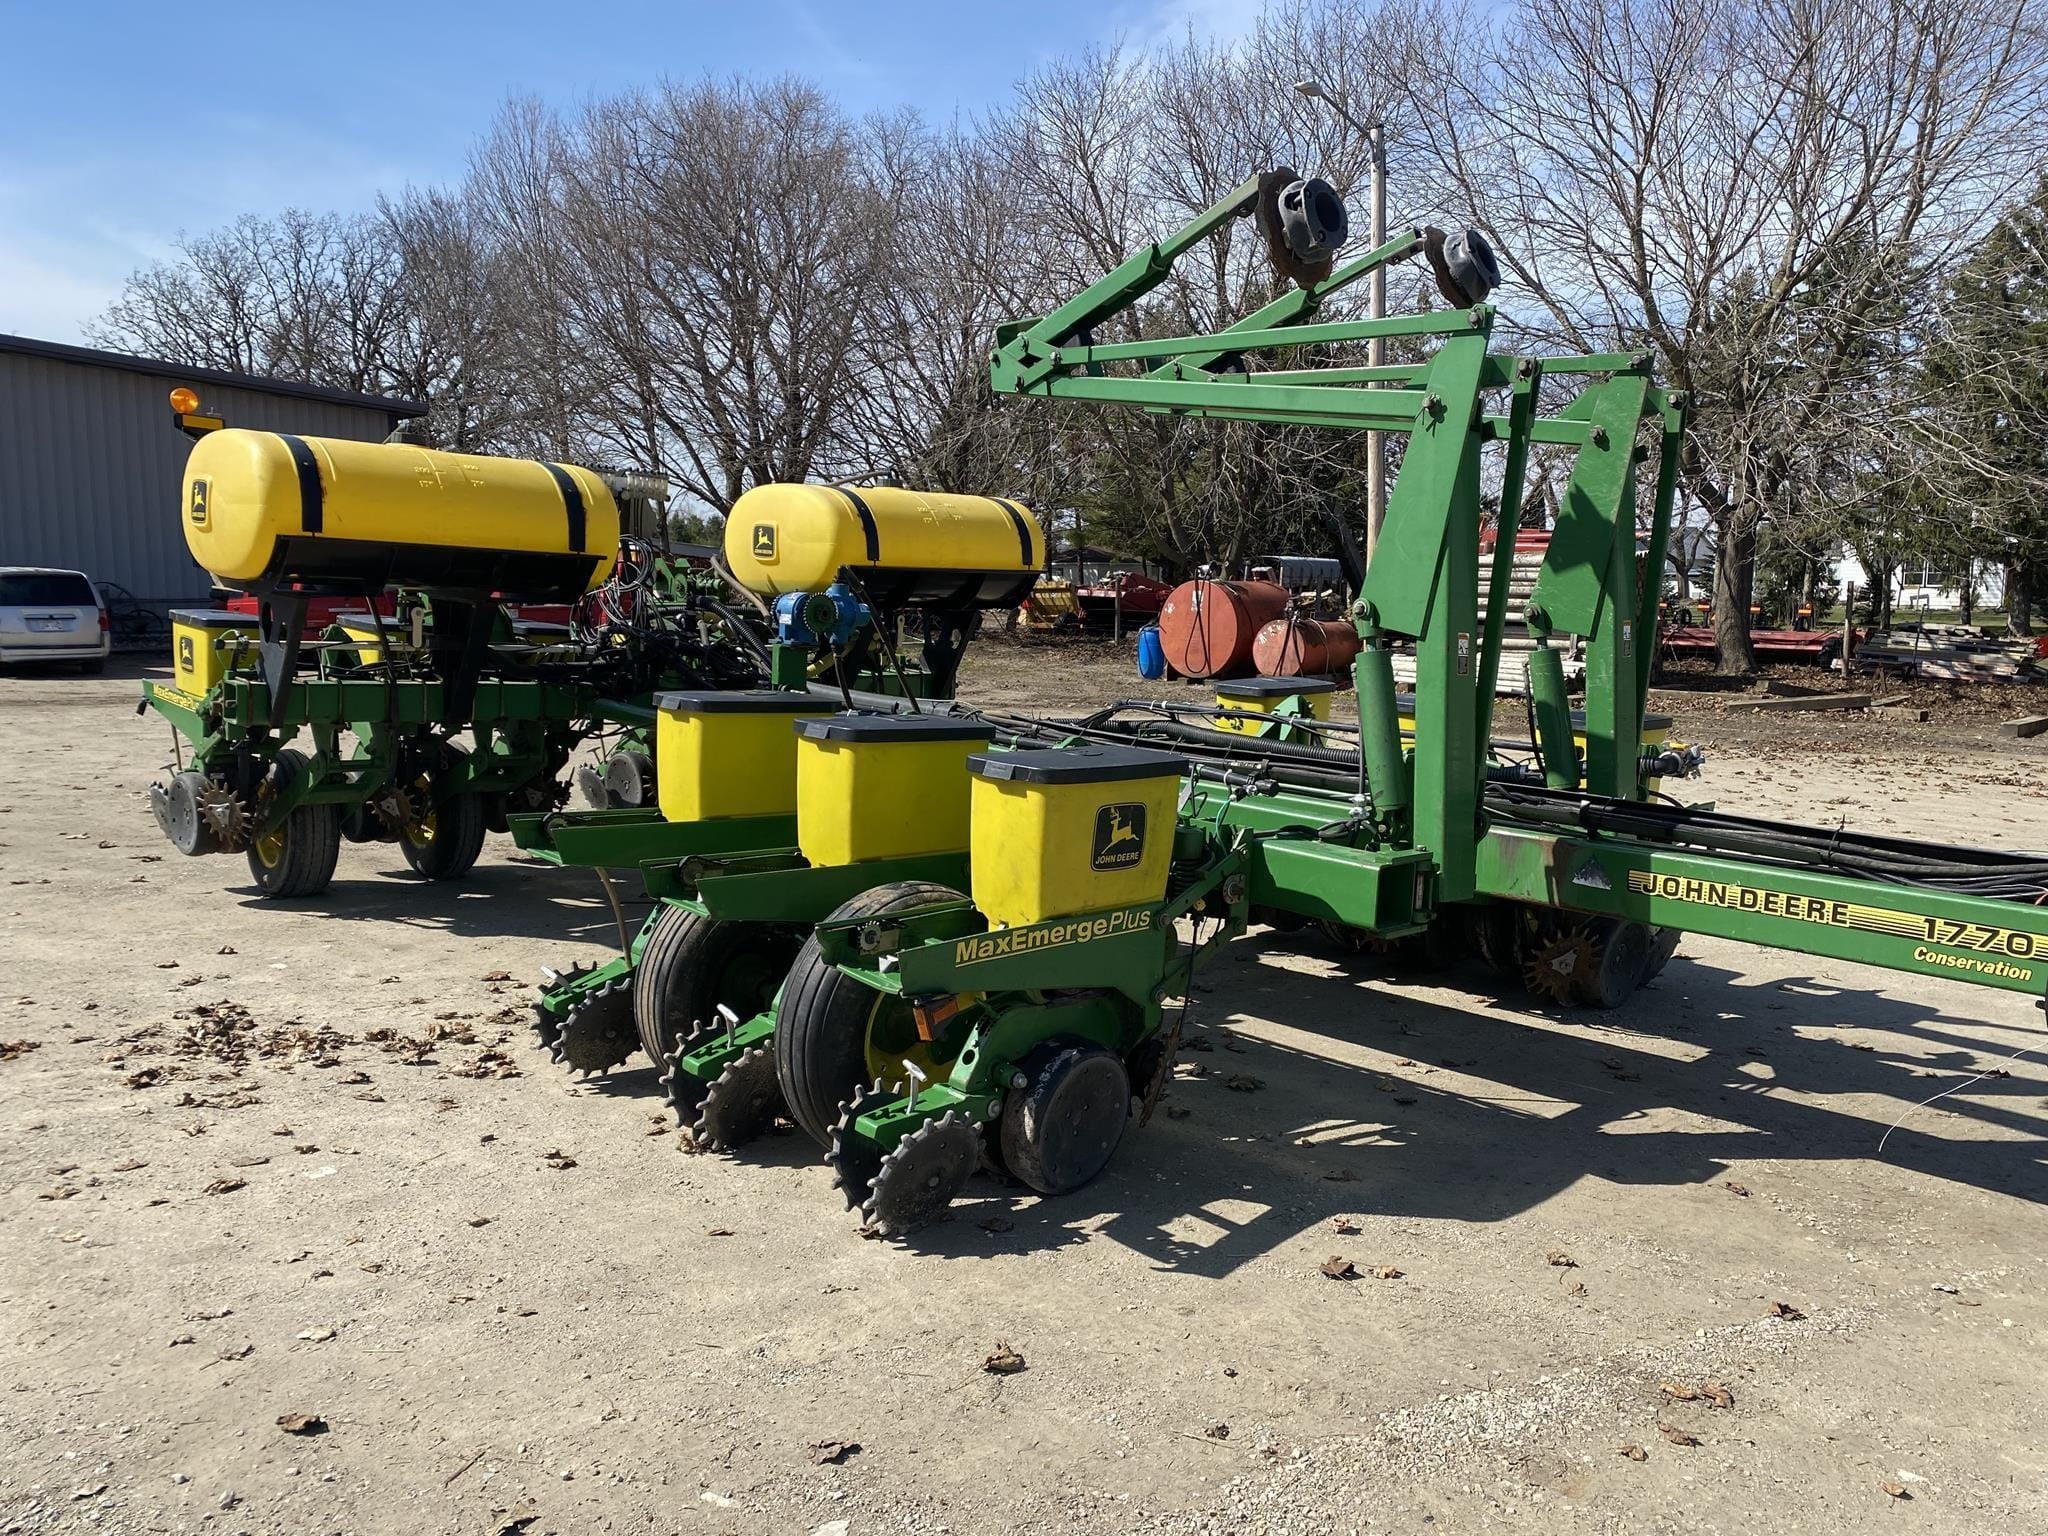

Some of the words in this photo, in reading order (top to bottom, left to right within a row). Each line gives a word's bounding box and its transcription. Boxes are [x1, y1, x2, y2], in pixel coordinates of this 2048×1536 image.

[1095, 855, 1116, 865] JOHN
[1116, 851, 1140, 862] DEERE
[1641, 873, 1729, 906] JOHN
[1737, 886, 1851, 927] DEERE
[1922, 917, 2036, 958] 1770
[1913, 946, 2032, 981] Conservation
